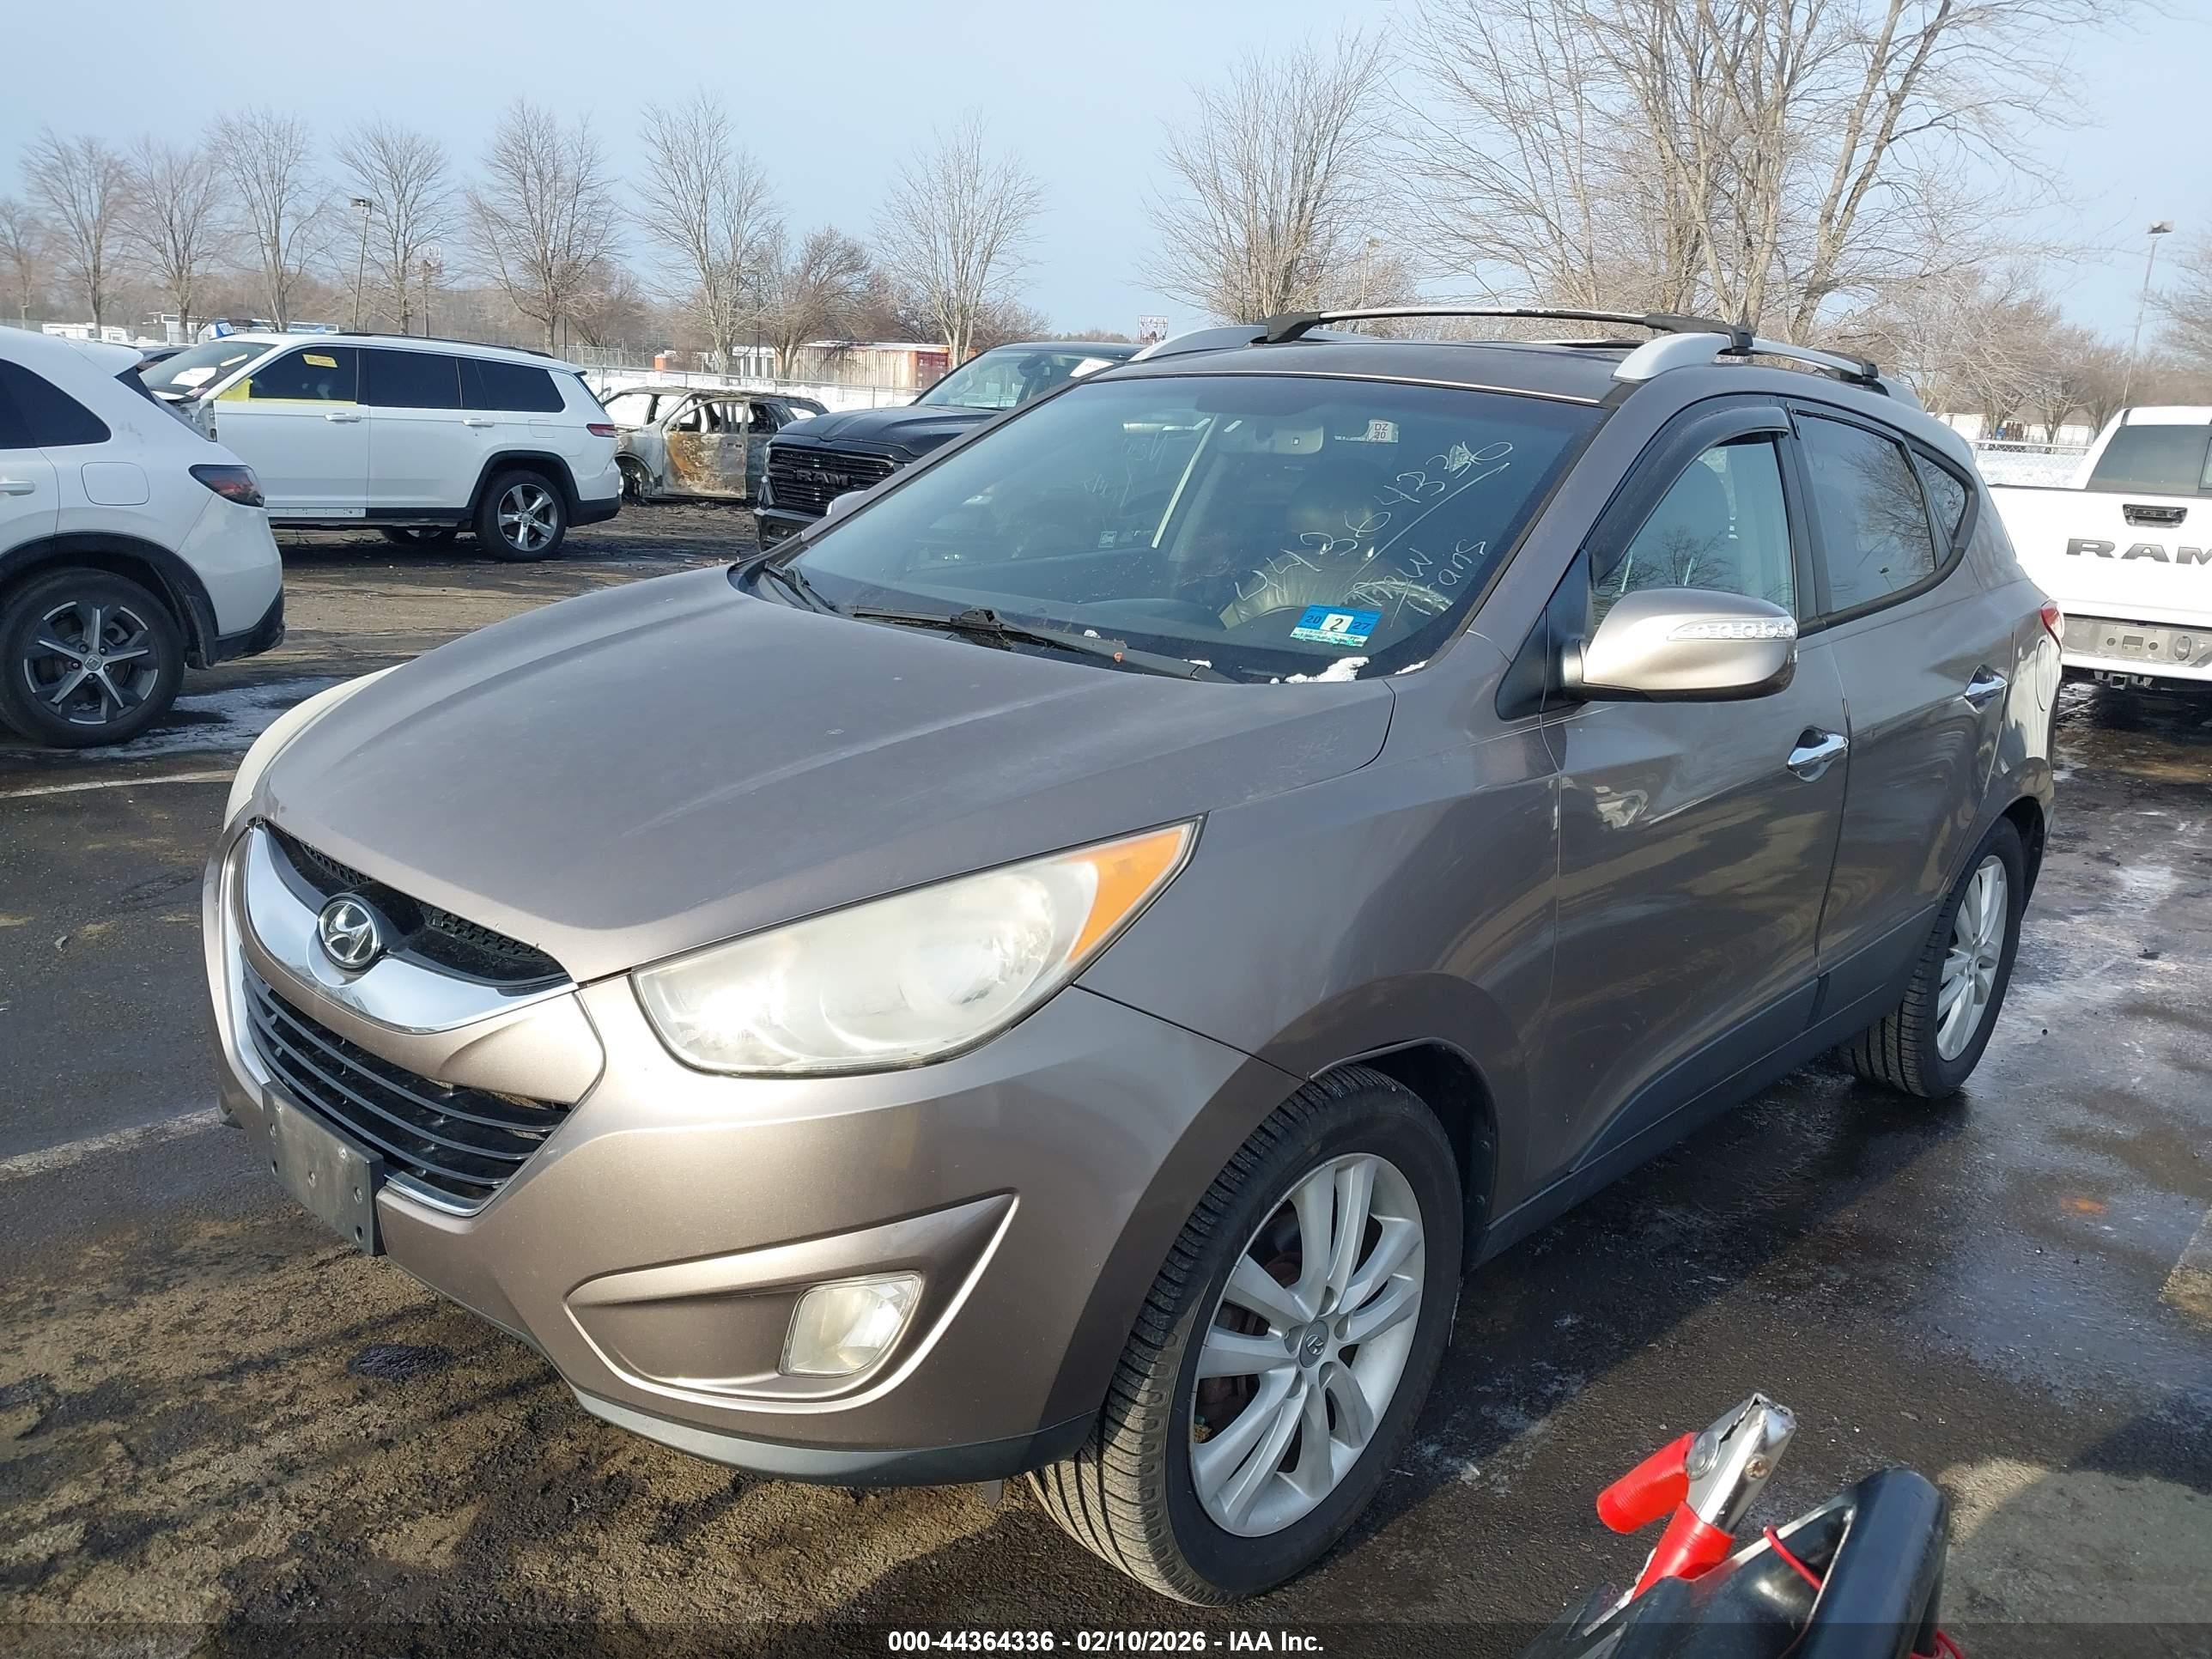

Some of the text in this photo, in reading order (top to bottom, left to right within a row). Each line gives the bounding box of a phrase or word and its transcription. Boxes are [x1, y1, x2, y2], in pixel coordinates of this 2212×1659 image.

[1375, 422, 1389, 431] DZ
[797, 470, 849, 487] RAM
[2066, 538, 2212, 565] RAM
[1305, 615, 1371, 631] 20 2 27
